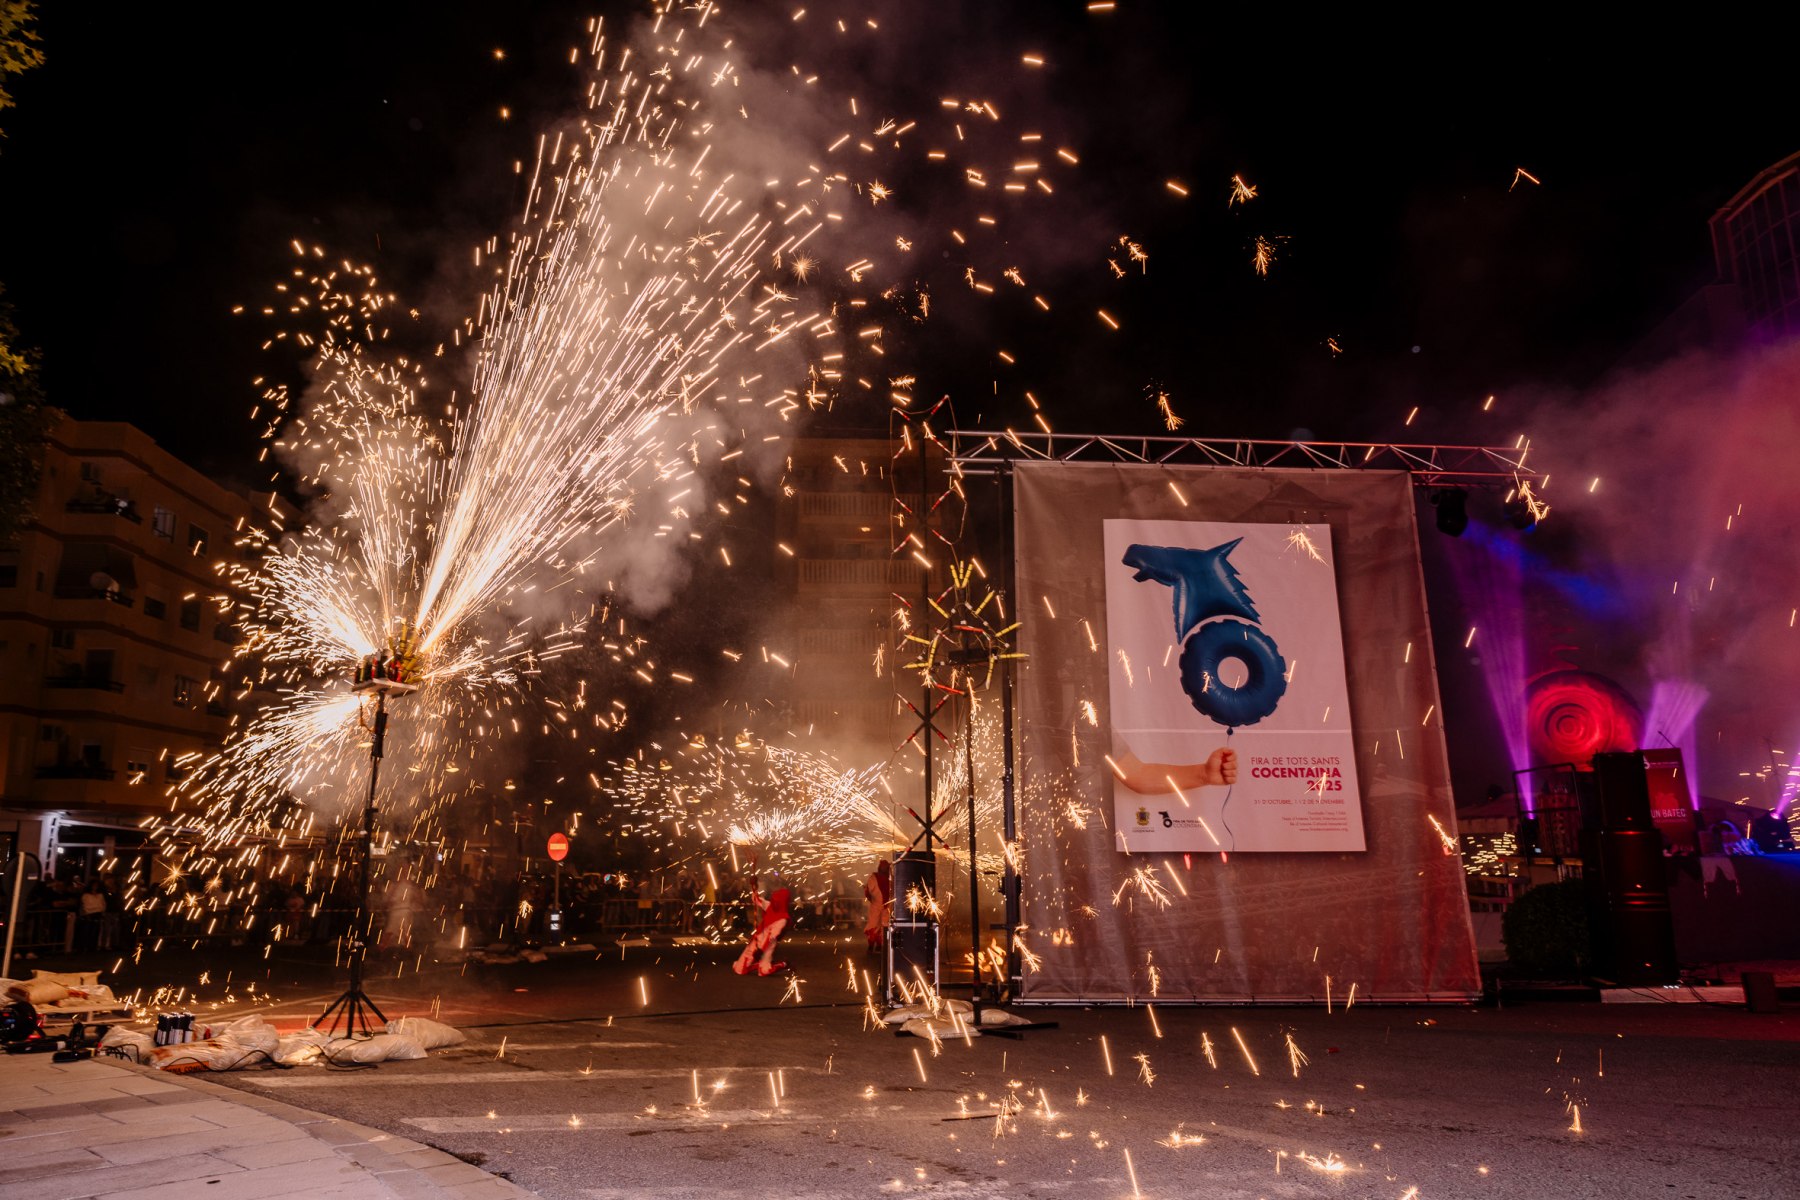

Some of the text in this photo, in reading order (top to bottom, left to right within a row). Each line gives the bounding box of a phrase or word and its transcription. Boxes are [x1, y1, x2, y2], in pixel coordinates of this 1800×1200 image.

[1250, 756, 1340, 765] FIRA DE TOTS SANTS
[1251, 767, 1342, 778] COCENTAINA
